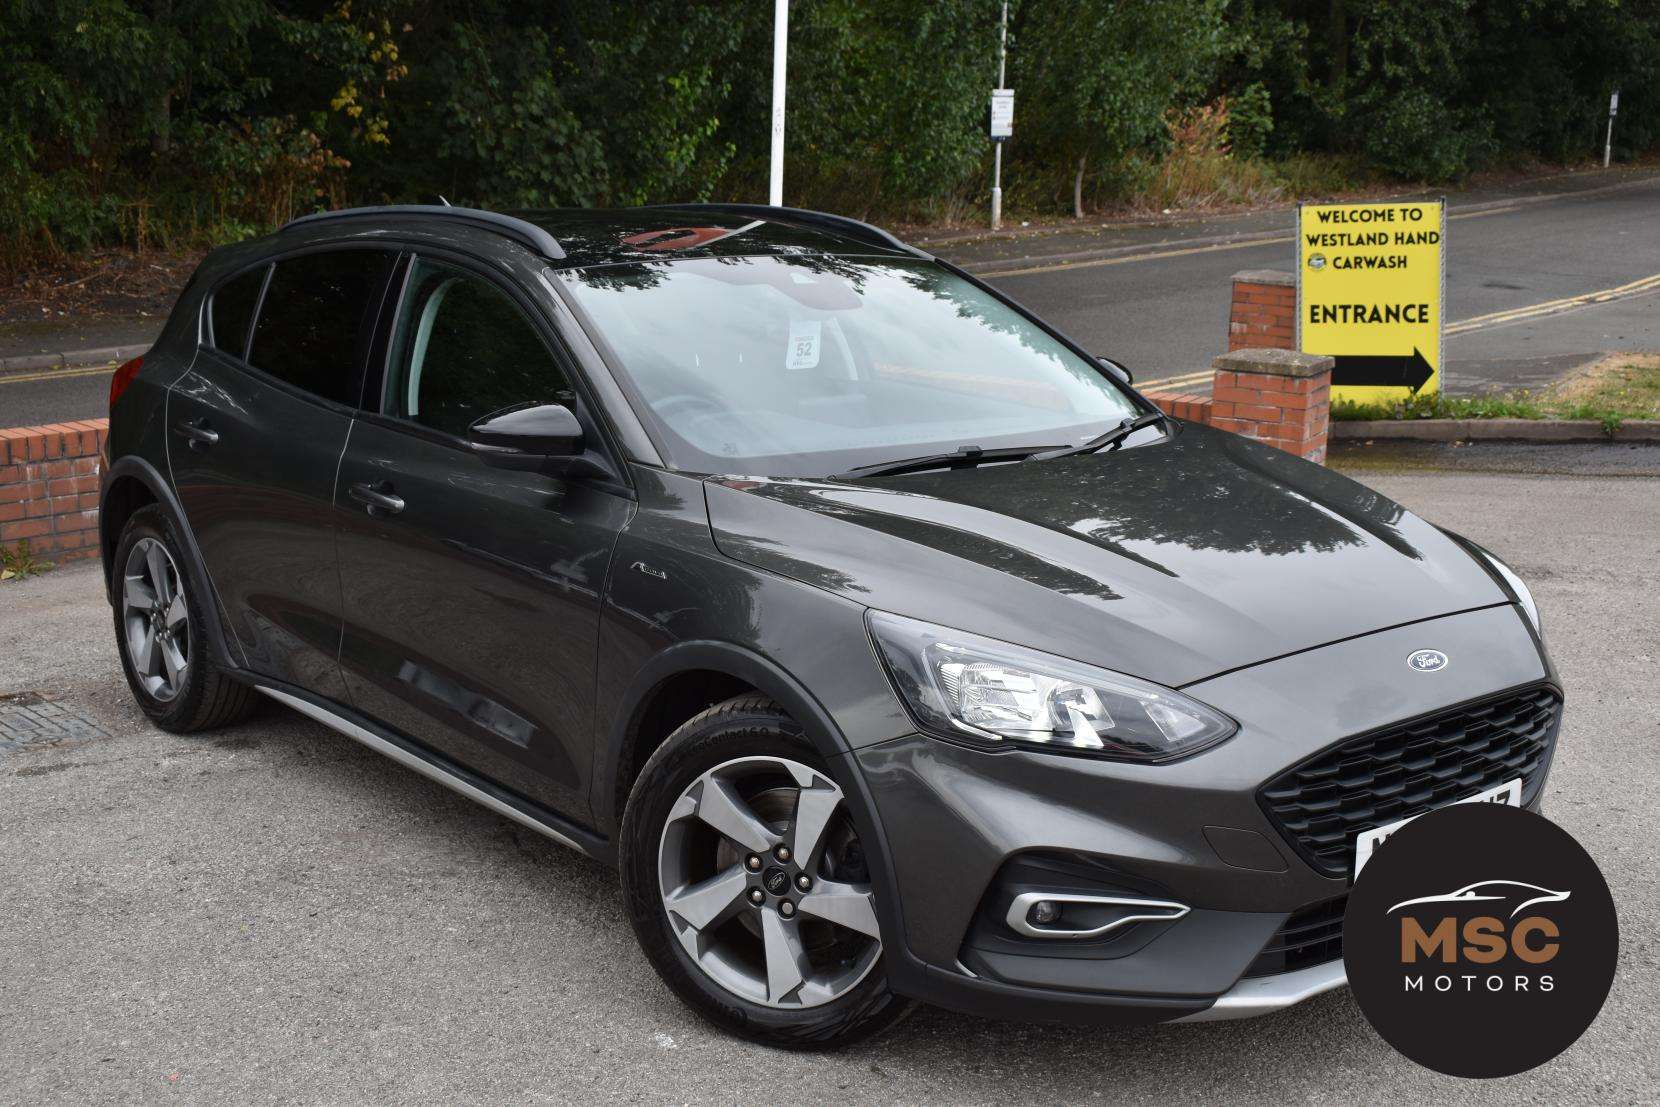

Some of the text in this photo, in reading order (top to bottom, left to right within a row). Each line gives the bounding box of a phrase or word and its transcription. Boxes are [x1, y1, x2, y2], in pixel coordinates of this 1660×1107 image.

[1317, 208, 1423, 223] WELCOME TO
[1306, 231, 1439, 247] WESTLAND HAND
[1333, 256, 1407, 269] CARWASH
[1310, 304, 1429, 324] ENTRANCE
[1417, 654, 1441, 668] Ford
